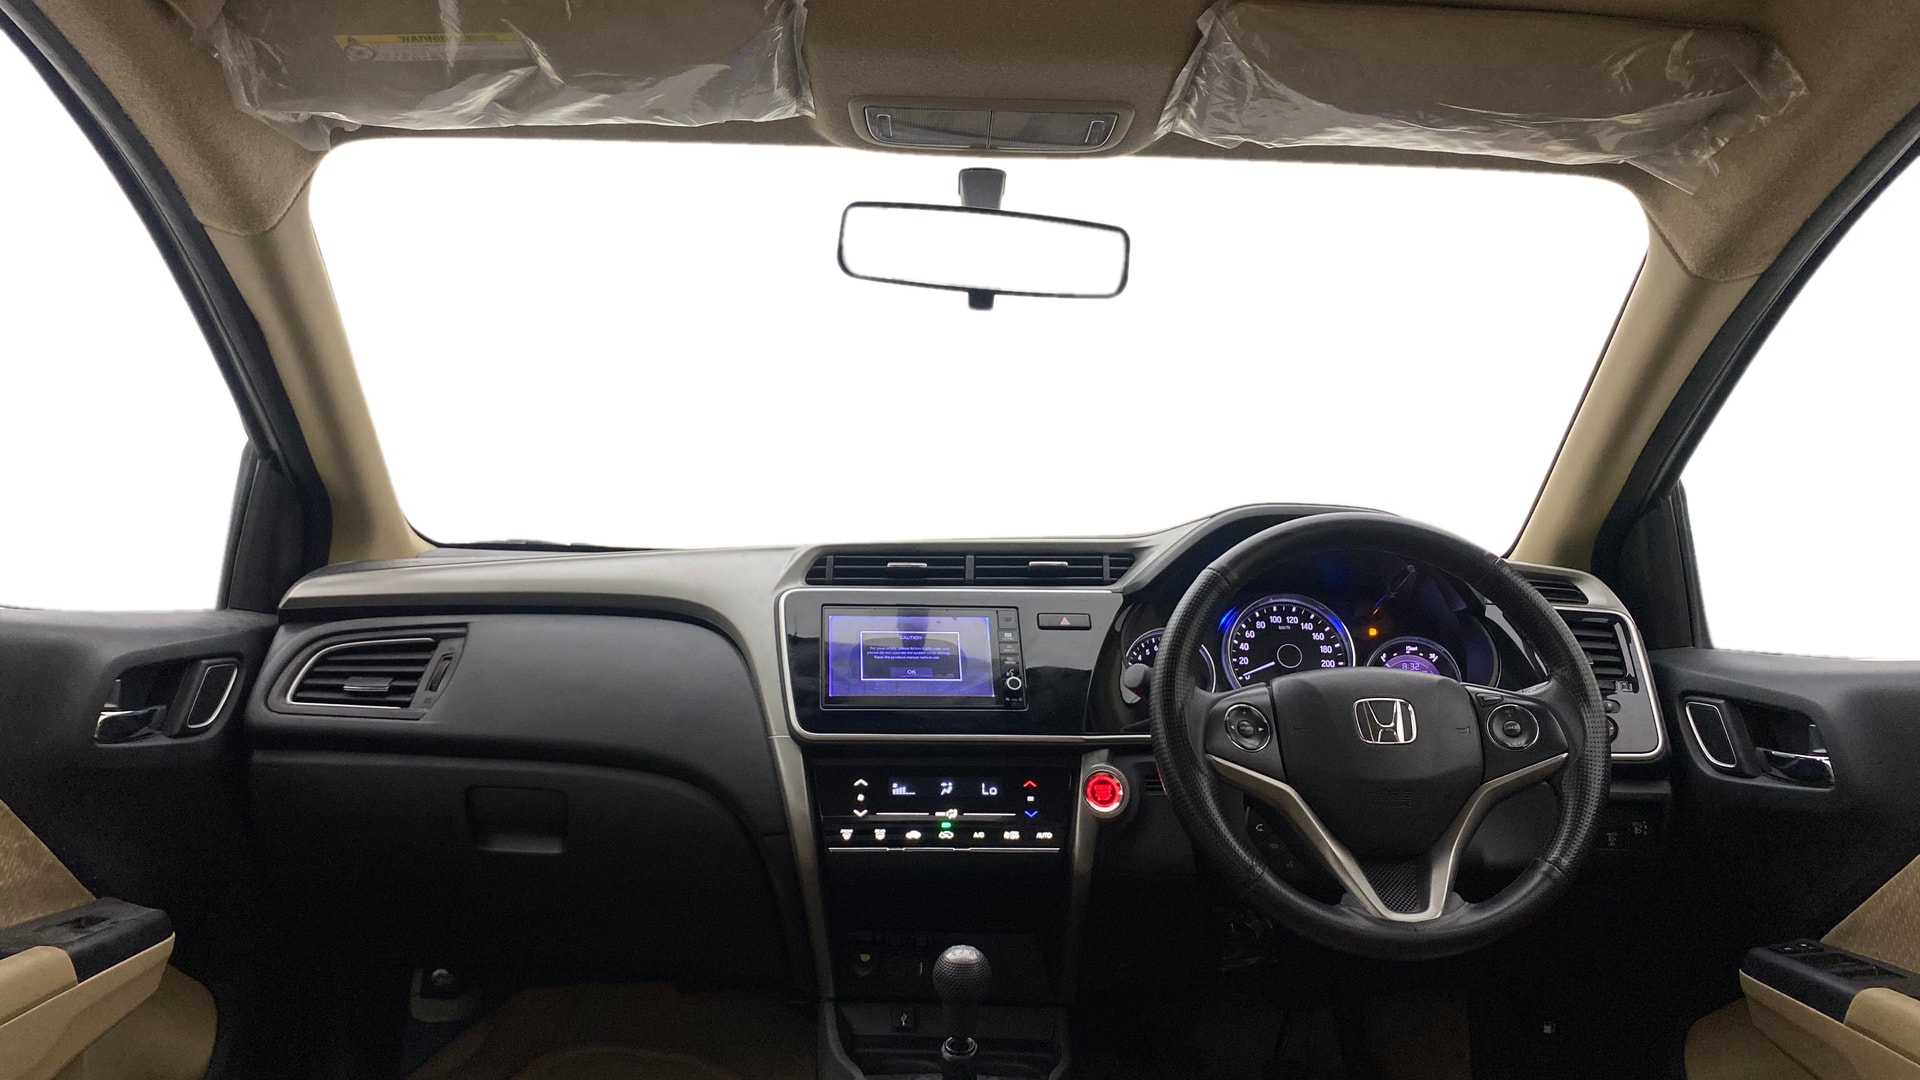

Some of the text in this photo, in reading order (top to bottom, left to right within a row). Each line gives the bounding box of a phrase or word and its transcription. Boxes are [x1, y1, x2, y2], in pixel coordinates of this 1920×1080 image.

[1312, 632, 1324, 640] 160
[1239, 642, 1249, 650] 40
[1320, 645, 1332, 654] 180
[1239, 656, 1249, 664] 20
[1321, 660, 1335, 668] 200
[982, 782, 998, 795] Lo
